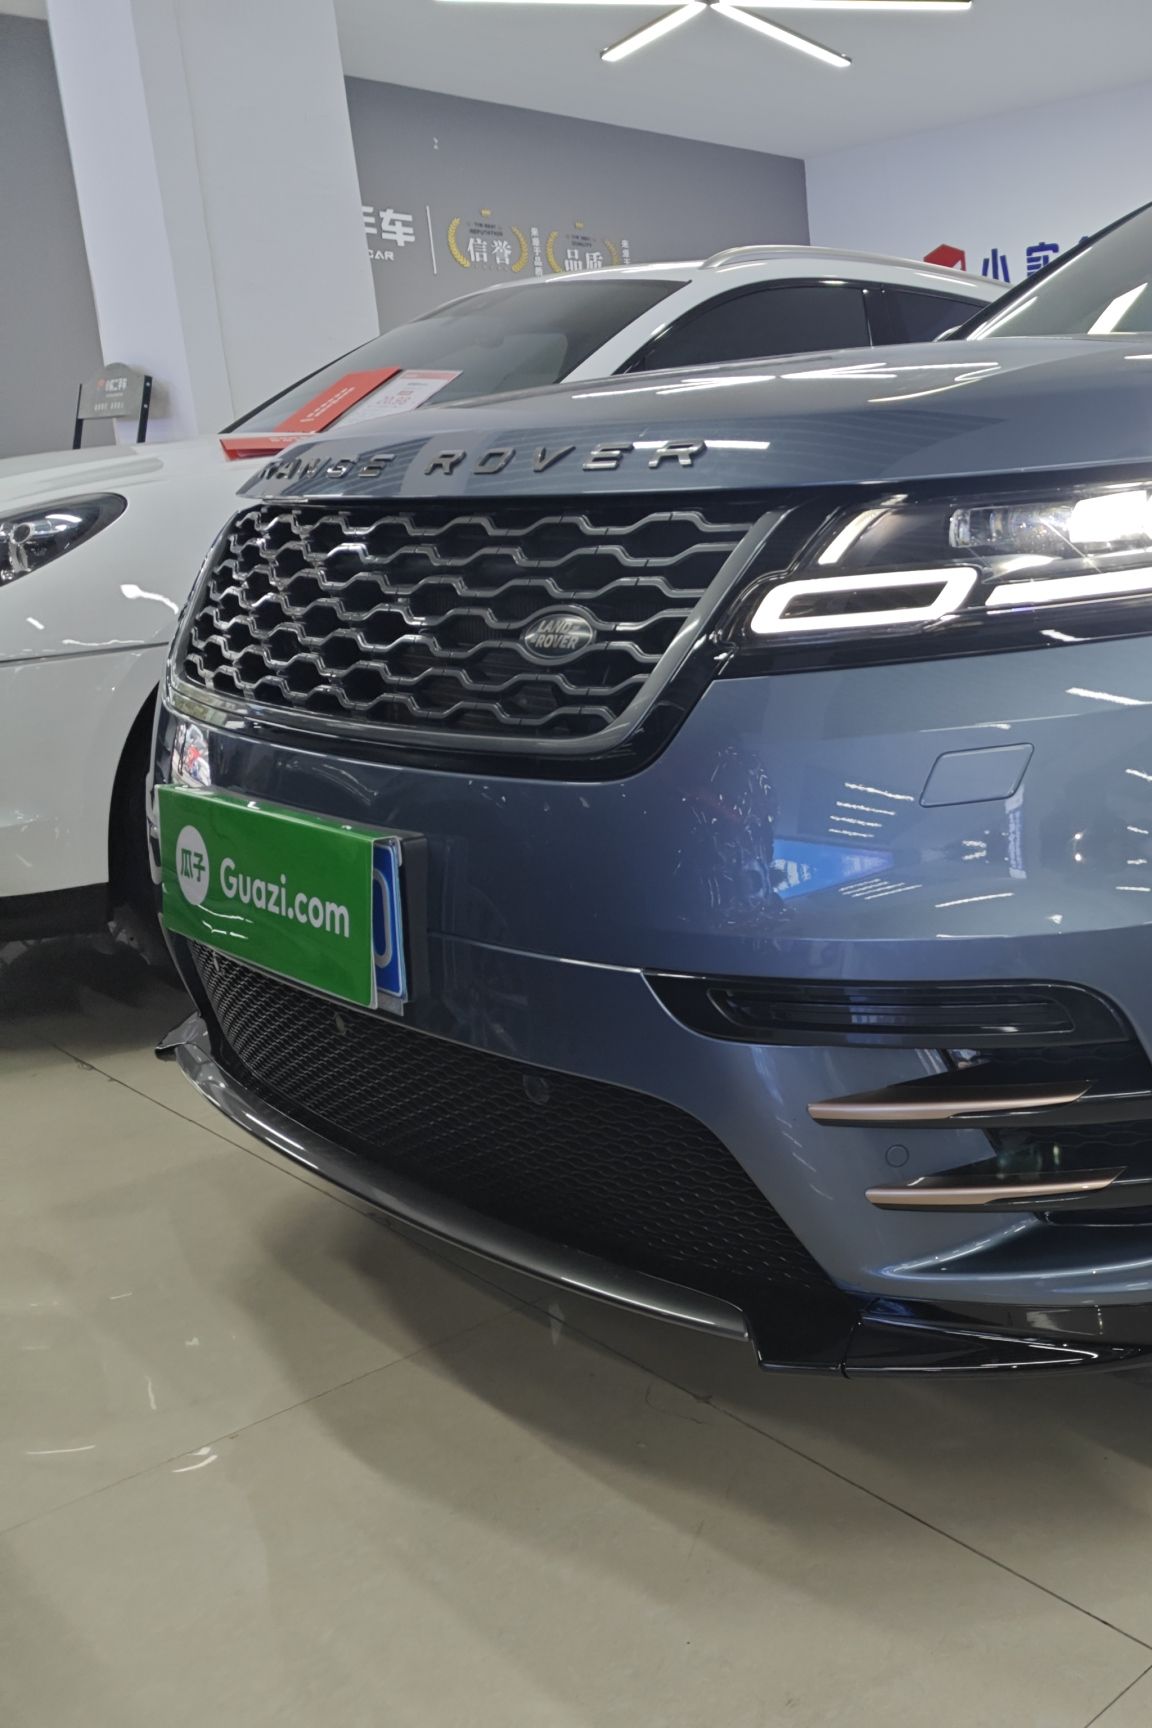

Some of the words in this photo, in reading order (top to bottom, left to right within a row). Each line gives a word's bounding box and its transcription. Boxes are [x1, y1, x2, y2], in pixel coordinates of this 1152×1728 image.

[467, 238, 512, 265] 信誉
[424, 440, 707, 476] ROVER
[535, 634, 579, 649] ROVER
[537, 620, 572, 633] LAND
[181, 847, 206, 883] 瓜子
[220, 857, 350, 938] Guazi.com
